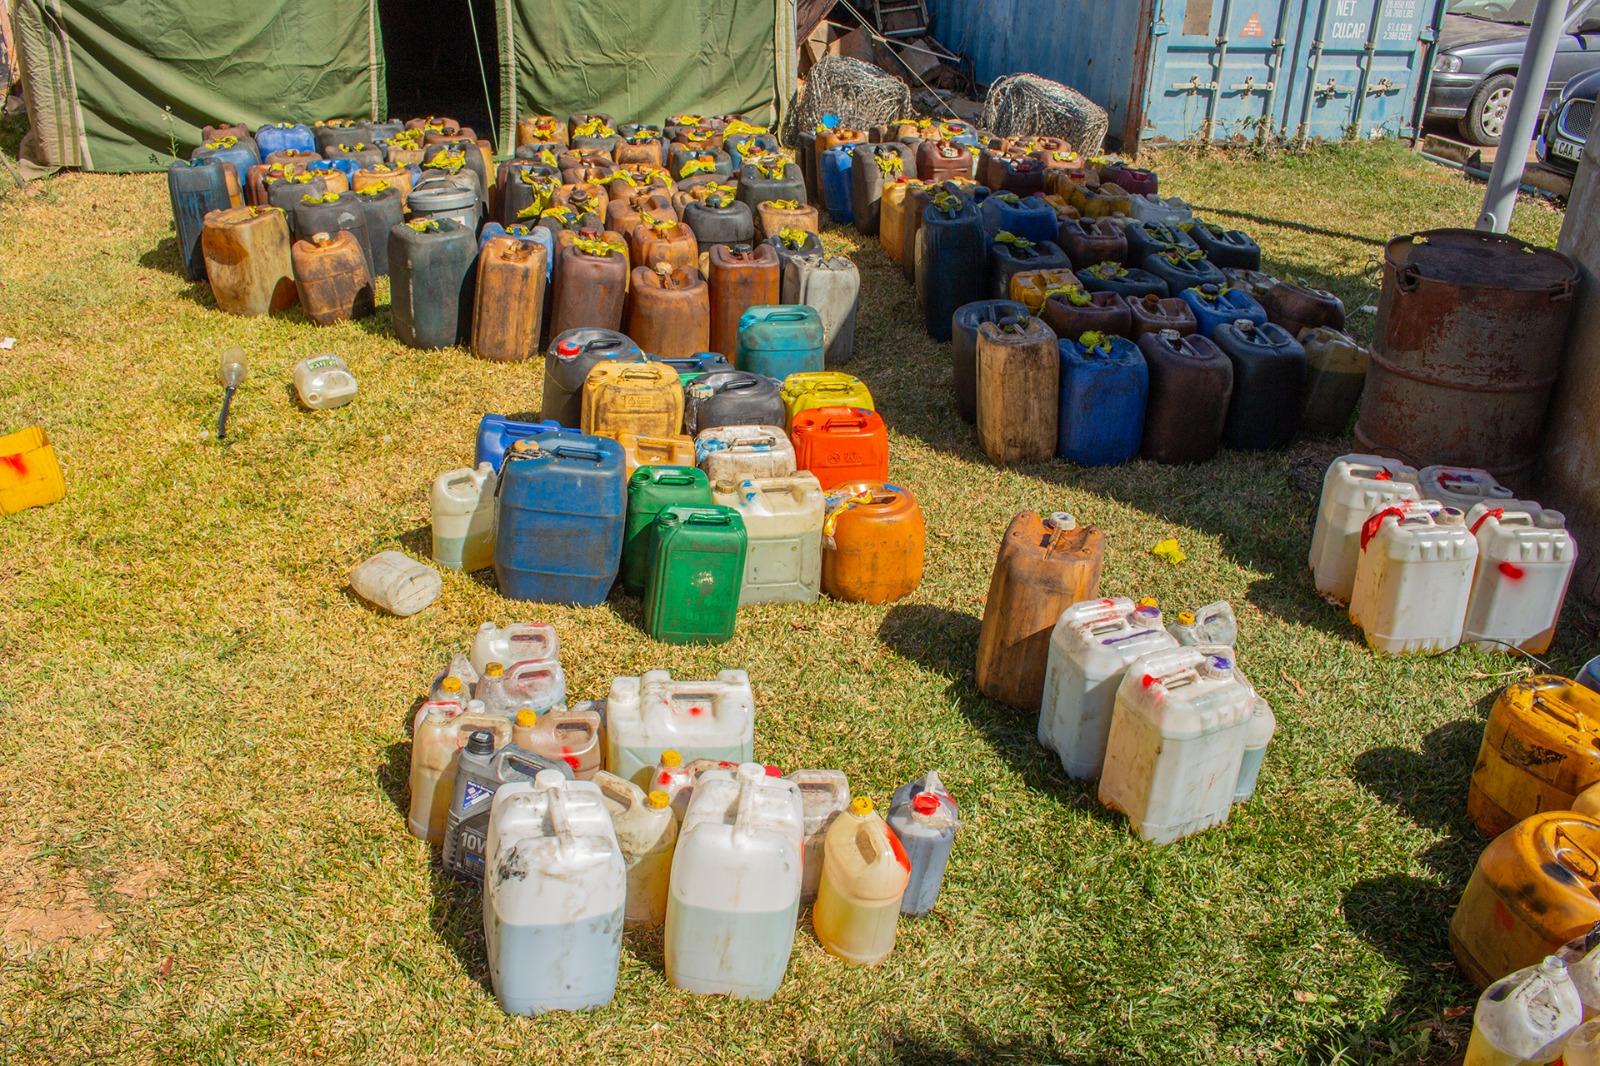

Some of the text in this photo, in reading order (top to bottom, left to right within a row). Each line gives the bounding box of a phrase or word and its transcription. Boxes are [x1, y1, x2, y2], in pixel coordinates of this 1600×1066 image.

[1336, 0, 1356, 16] NET
[1332, 22, 1365, 38] CU.CAP.
[1559, 142, 1573, 157] CAA
